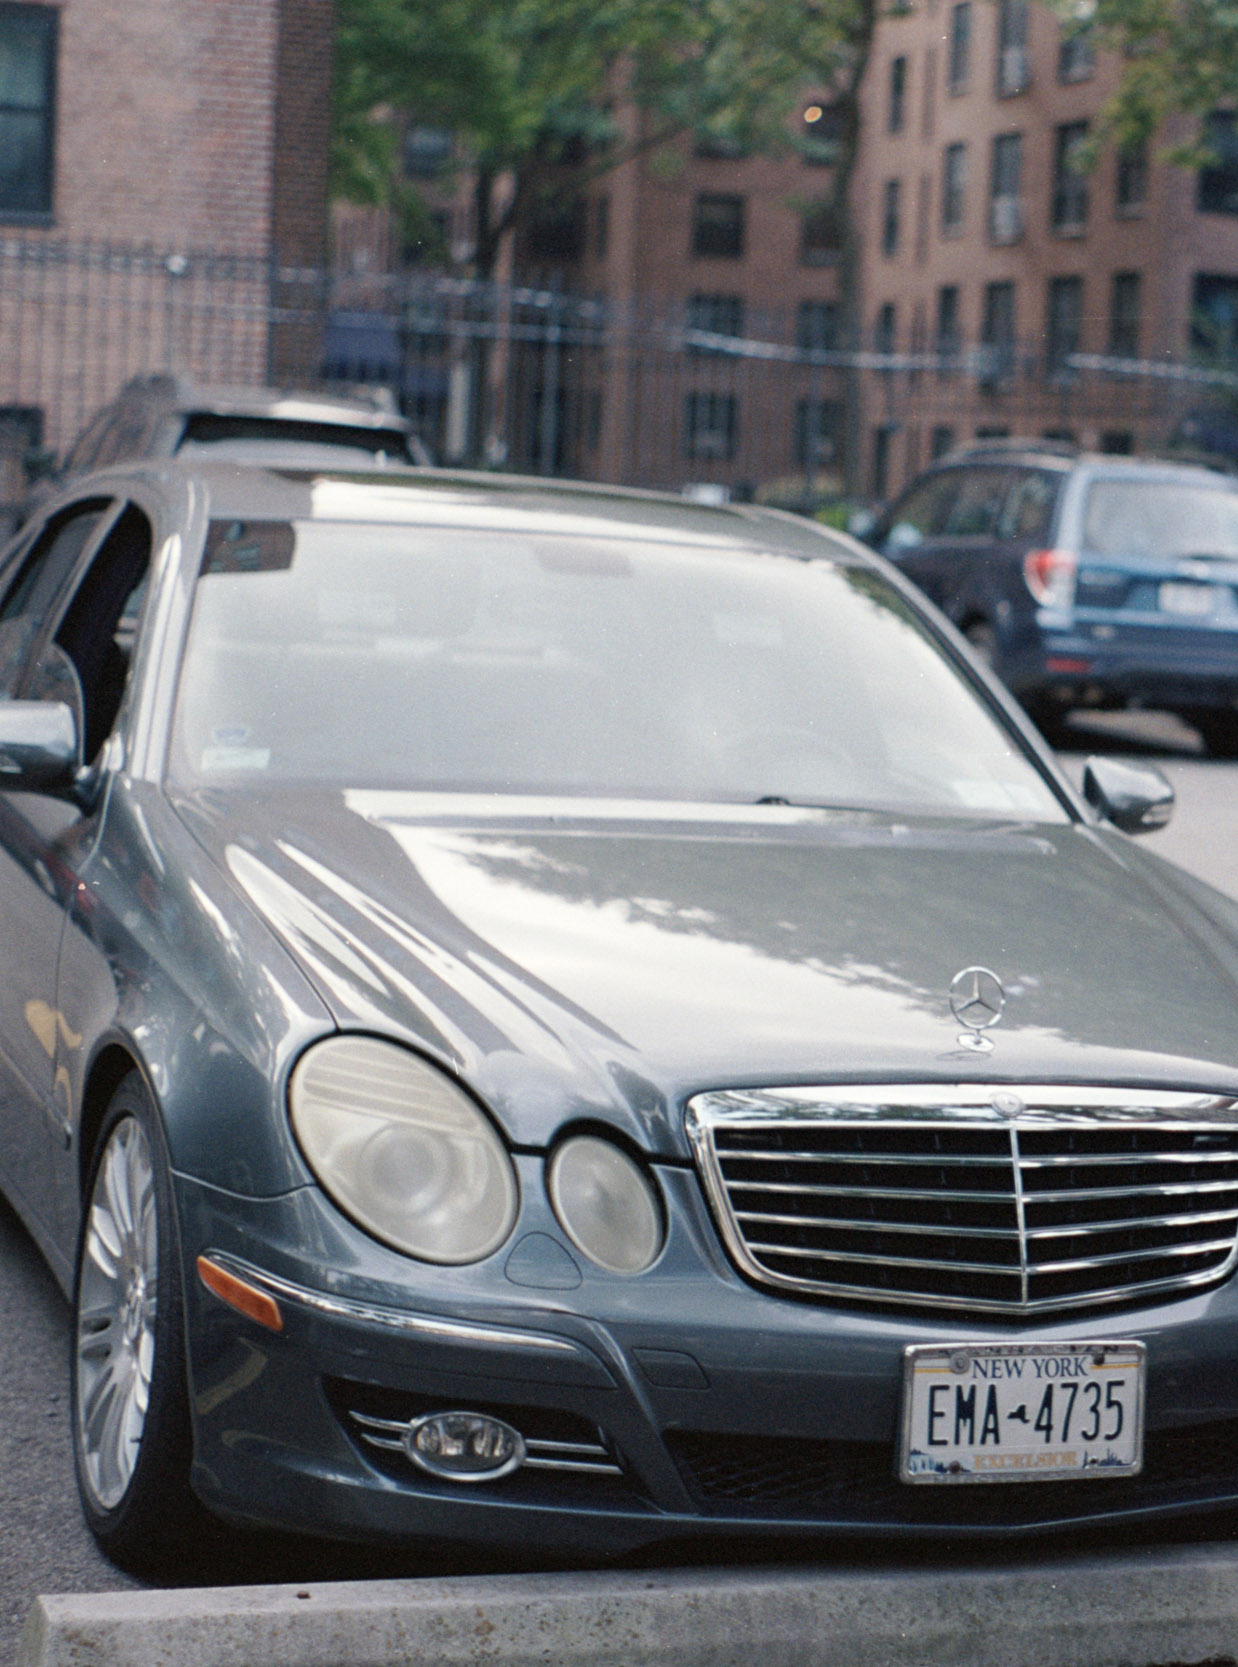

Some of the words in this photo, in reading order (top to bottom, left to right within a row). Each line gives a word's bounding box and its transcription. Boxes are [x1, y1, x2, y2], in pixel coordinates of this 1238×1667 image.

[972, 1359, 1026, 1379] NEW
[1032, 1357, 1088, 1378] YORK
[928, 1384, 1000, 1445] EMA
[1034, 1380, 1125, 1444] 4735
[974, 1451, 1078, 1470] EXCELSIOR
